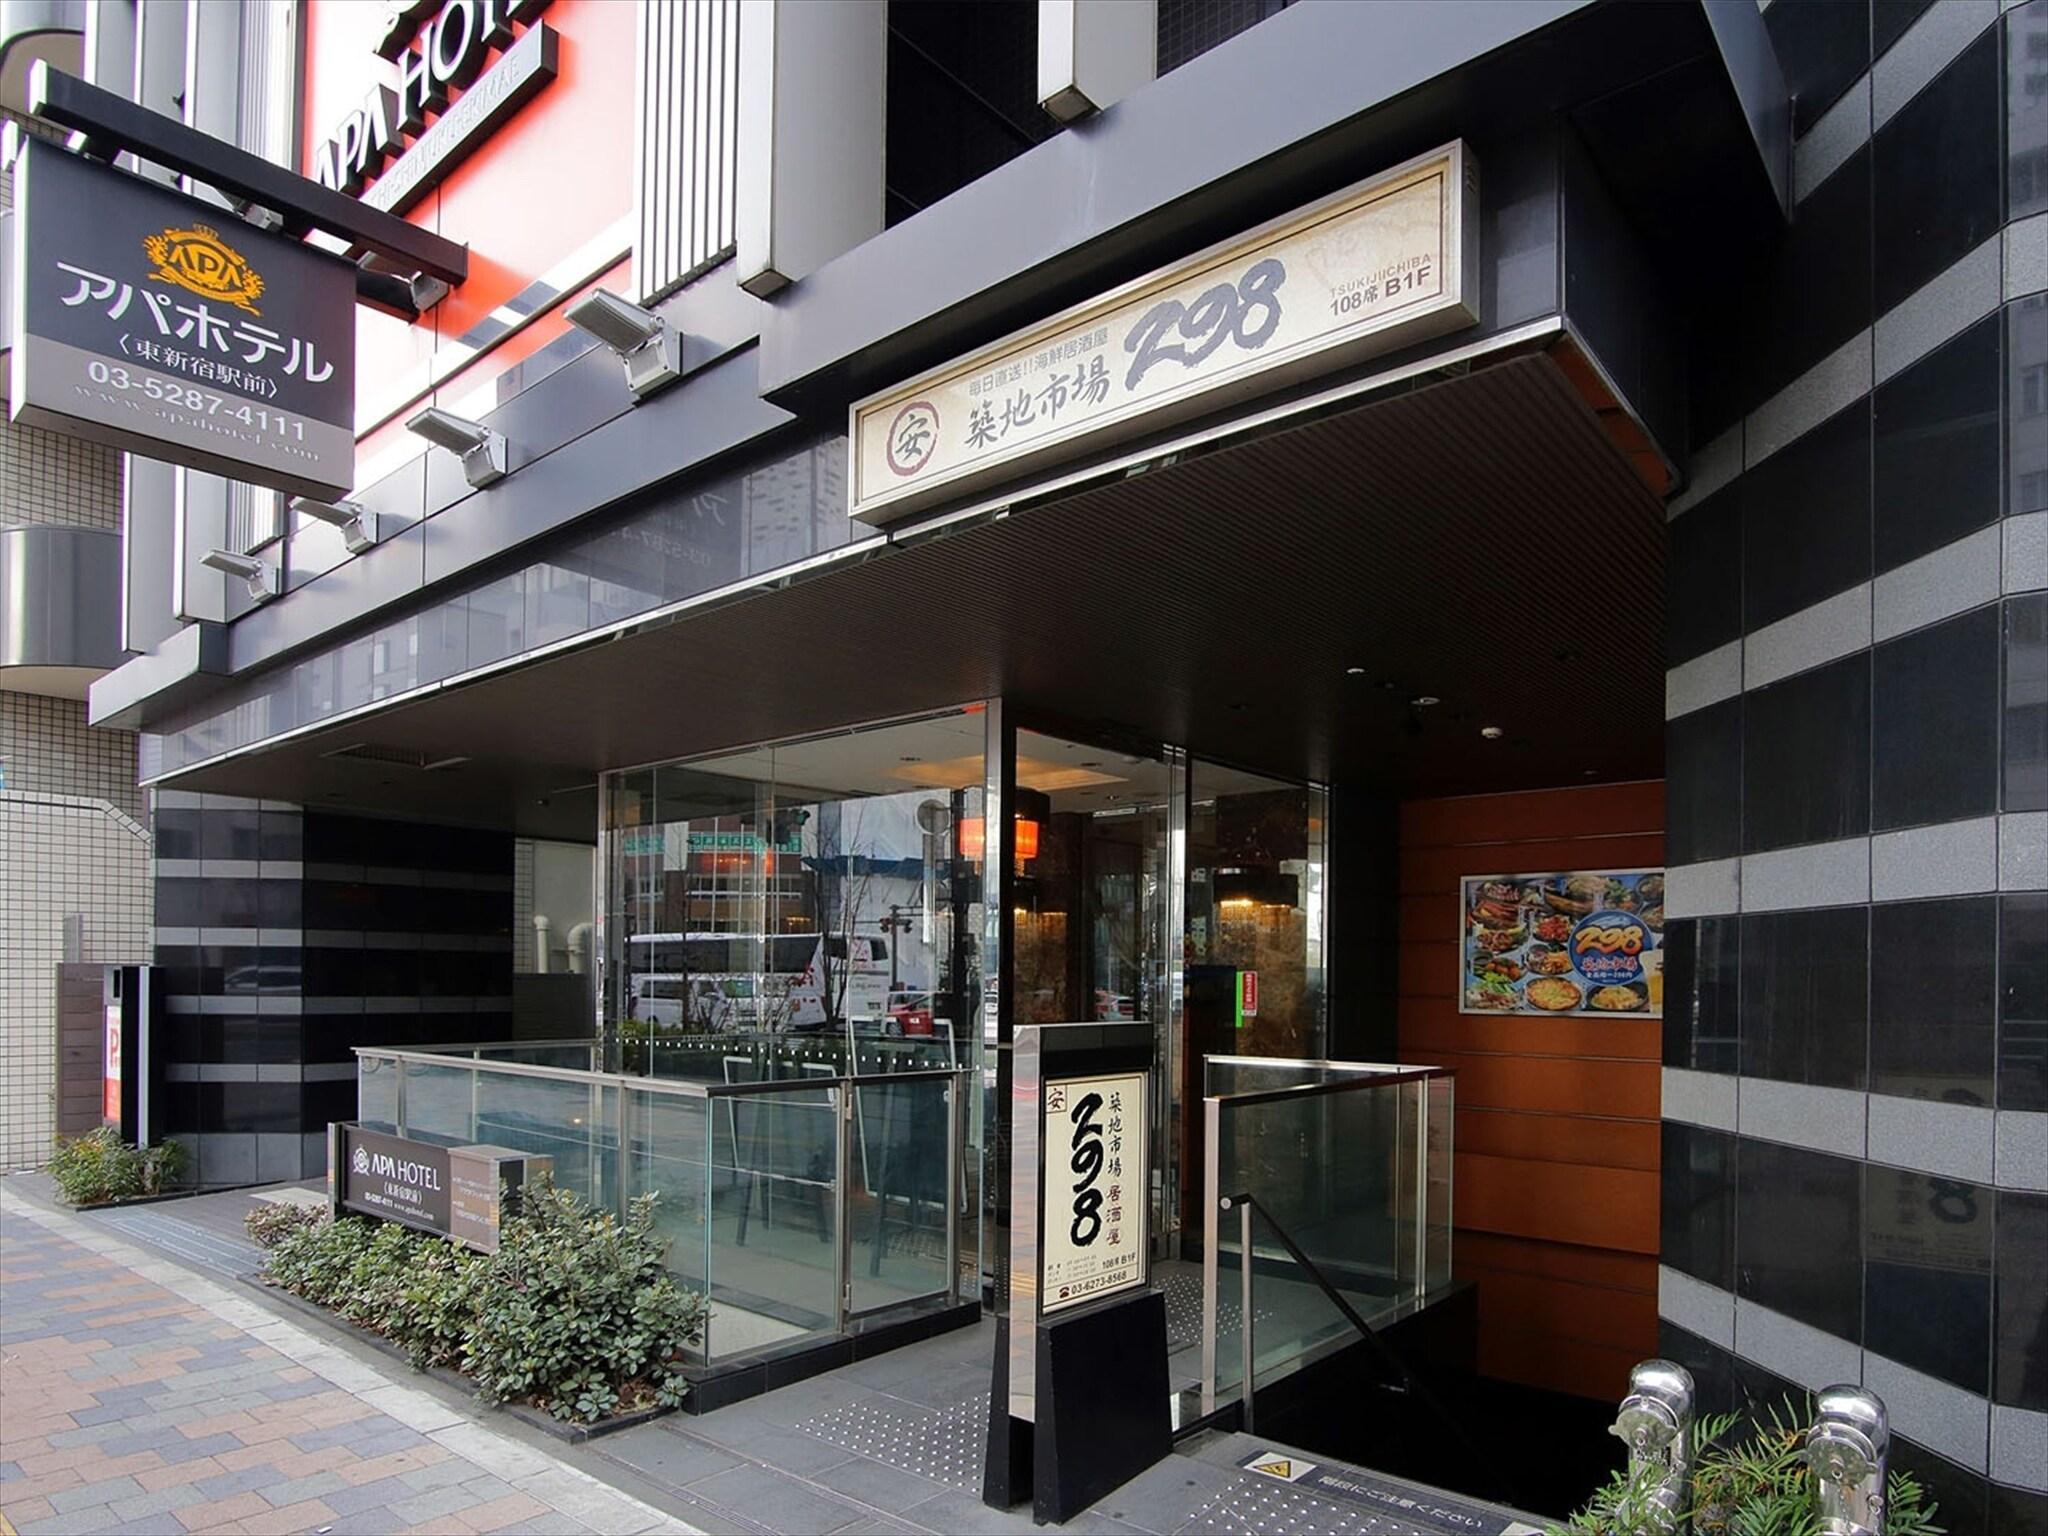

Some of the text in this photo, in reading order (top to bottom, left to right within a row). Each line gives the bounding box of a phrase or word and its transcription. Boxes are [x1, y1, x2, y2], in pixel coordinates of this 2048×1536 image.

[1385, 265, 1431, 297] B1F
[56, 261, 335, 383] アパホテル
[895, 258, 1287, 460] 安 築地市場 298
[88, 361, 305, 441] 03-5287-4111
[1047, 1087, 1065, 1111] 安
[372, 1153, 396, 1178] APA
[398, 1160, 441, 1191] HOTEL
[1070, 1092, 1105, 1247] 298
